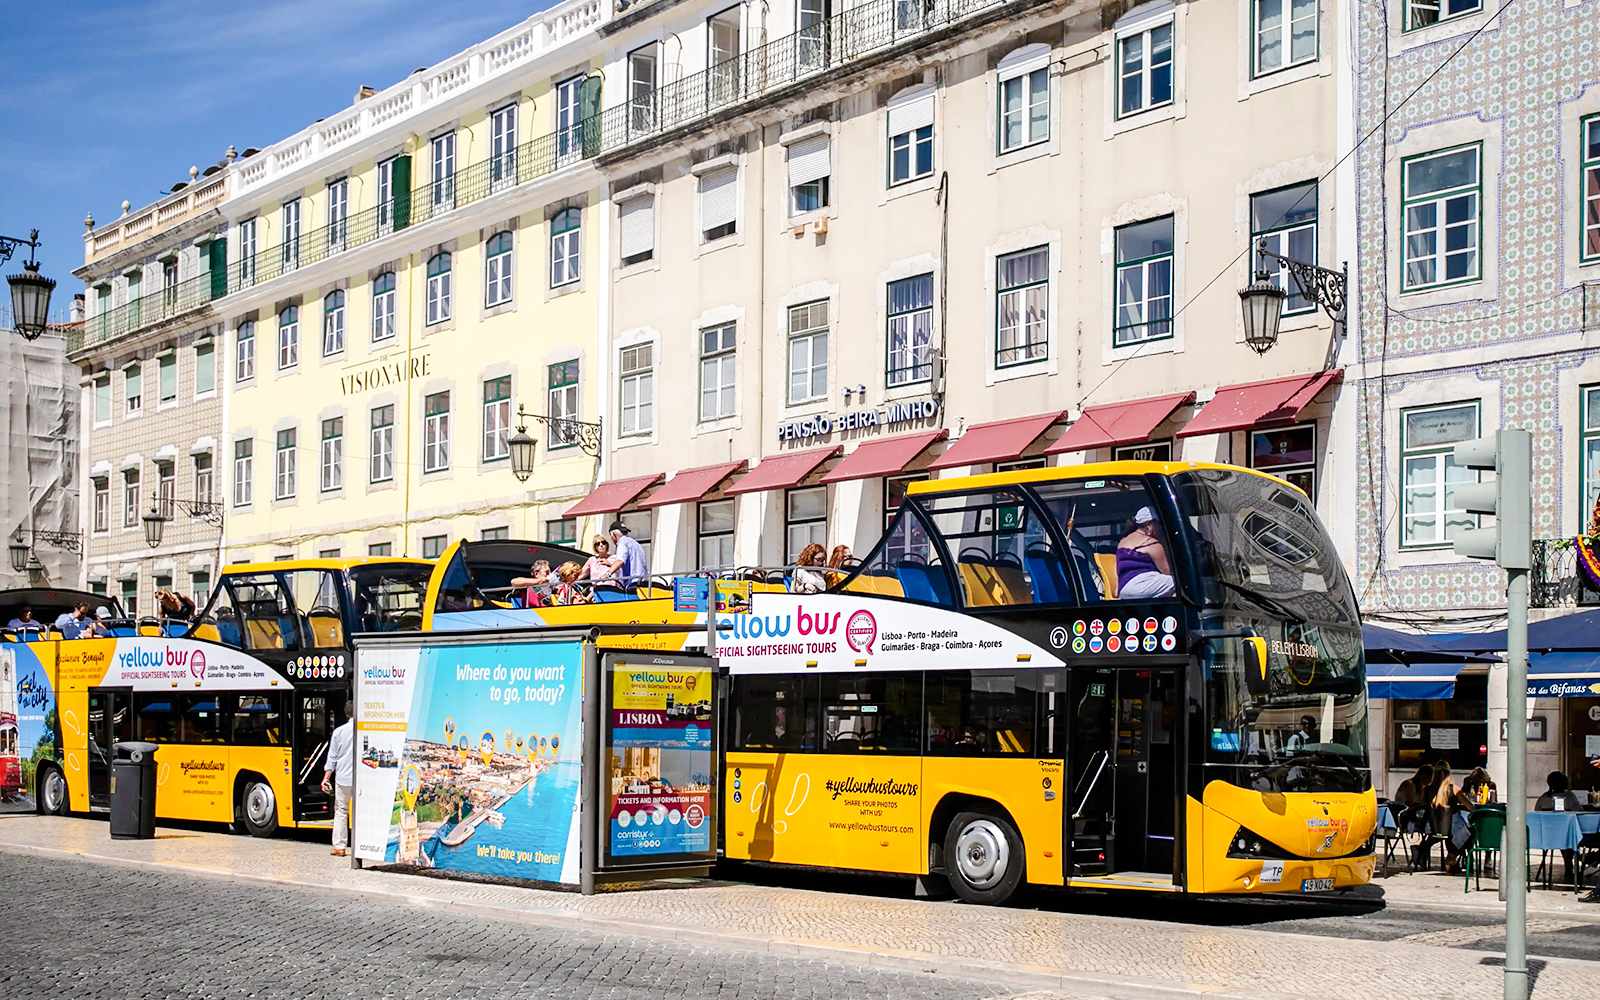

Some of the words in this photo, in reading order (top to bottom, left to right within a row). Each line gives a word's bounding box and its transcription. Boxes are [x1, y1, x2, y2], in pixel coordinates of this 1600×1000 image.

[341, 353, 431, 396] VISIONAIRE
[777, 414, 833, 441] PENSÃO
[837, 408, 881, 432] BEIRA
[886, 400, 939, 424] MINHO
[798, 604, 841, 636] bus
[882, 632, 902, 640] Lisboa
[907, 631, 926, 639] Porto
[931, 629, 958, 638] Madeira
[715, 646, 744, 657] FFICIAL
[746, 644, 804, 656] SIGHTSEEING
[806, 642, 837, 654] TOURS
[881, 642, 915, 652] Guimarães
[920, 642, 940, 651] Braga
[945, 640, 973, 649] Coimbra
[979, 639, 1002, 650] Açores
[119, 647, 163, 667] yellow
[166, 645, 188, 666] bus
[121, 672, 140, 680] OFFICIAL
[140, 671, 170, 679] SIGHTSEEING
[364, 666, 391, 678] yellow
[392, 665, 406, 678] bus
[456, 664, 490, 681] Where
[493, 663, 507, 681] do
[508, 667, 530, 685] you
[534, 664, 565, 681] want
[630, 672, 665, 682] yellow
[667, 672, 684, 683] bus
[490, 686, 501, 701] to
[504, 687, 521, 705] go,
[525, 684, 565, 705] today?
[1550, 682, 1586, 697] Bifanas
[619, 713, 662, 724] LISBON
[825, 777, 918, 800] #yellowbustours
[829, 821, 914, 834] www.yellowbustours.com
[1306, 816, 1329, 827] yellow
[1330, 817, 1340, 827] bus
[476, 844, 495, 857] We'll
[497, 847, 515, 861] take
[516, 851, 533, 864] you
[535, 850, 560, 865] there!
[1272, 867, 1283, 876] TP
